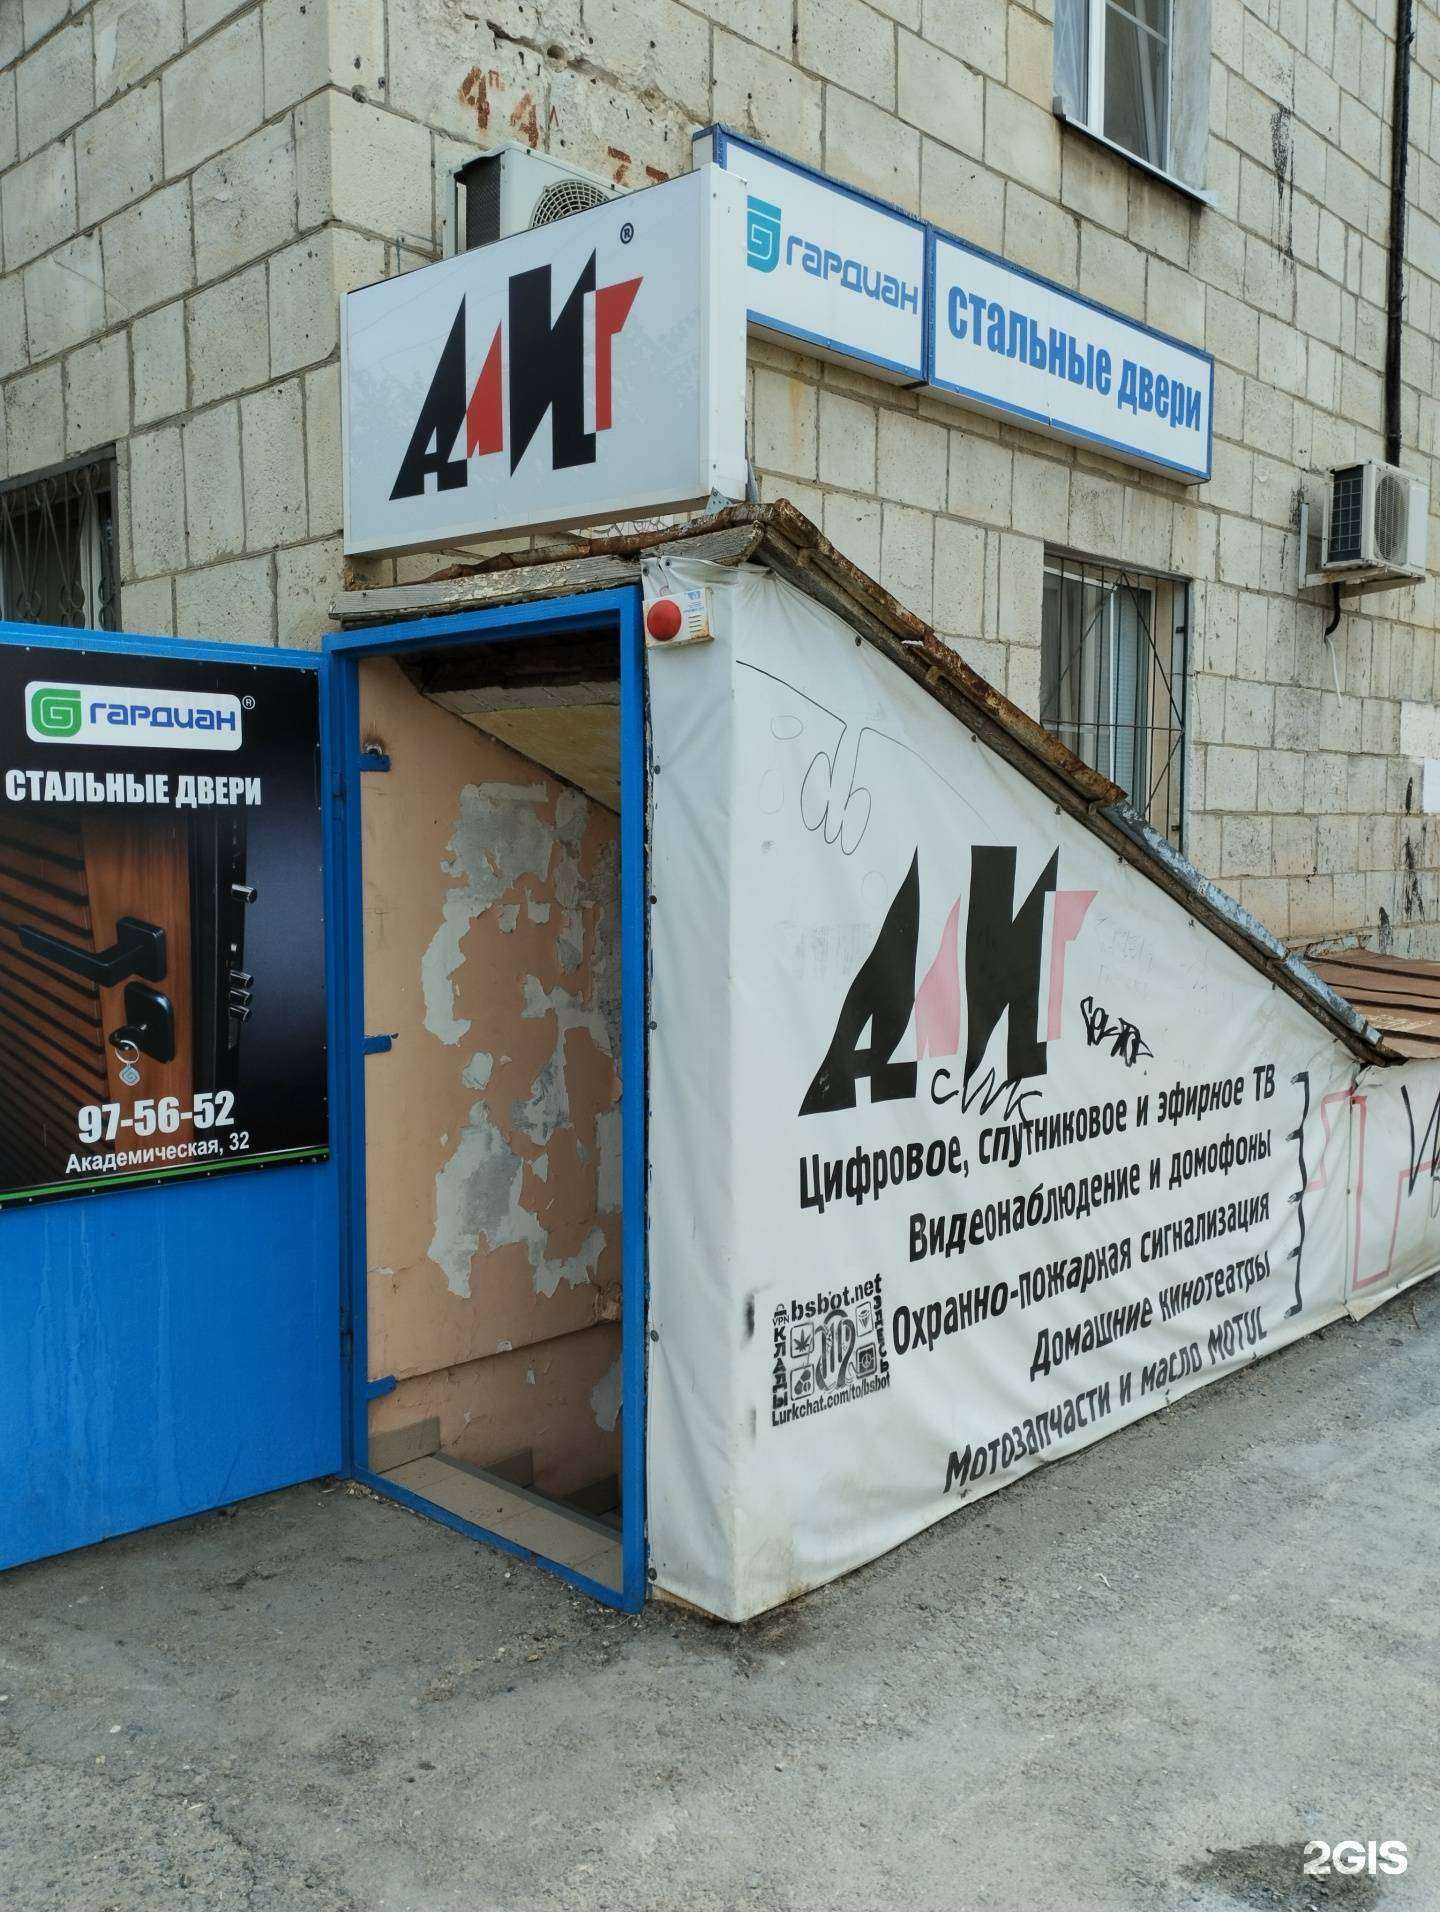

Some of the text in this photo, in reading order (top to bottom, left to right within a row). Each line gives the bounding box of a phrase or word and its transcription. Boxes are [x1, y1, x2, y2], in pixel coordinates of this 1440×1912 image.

[1117, 358, 1202, 432] двери
[5, 769, 262, 809] СТАЛЬНЫЕ ДВЕРИ
[65, 1131, 250, 1175] Академическая, 32
[78, 1090, 235, 1144] 97-56-52
[799, 1063, 1276, 1215] Цифровое, спутниковое и эфирное ТВ
[909, 1129, 1272, 1263] Видеонаблюдение и домофоны
[791, 1273, 882, 1322] bsbot.net
[892, 1191, 1271, 1356] Охранно-пожарная сигнализация
[772, 1315, 790, 1326] VPN
[1030, 1250, 1272, 1382] Домашние кинотеатры
[942, 1305, 1268, 1494] Мотозапчасти и масло MOTUL
